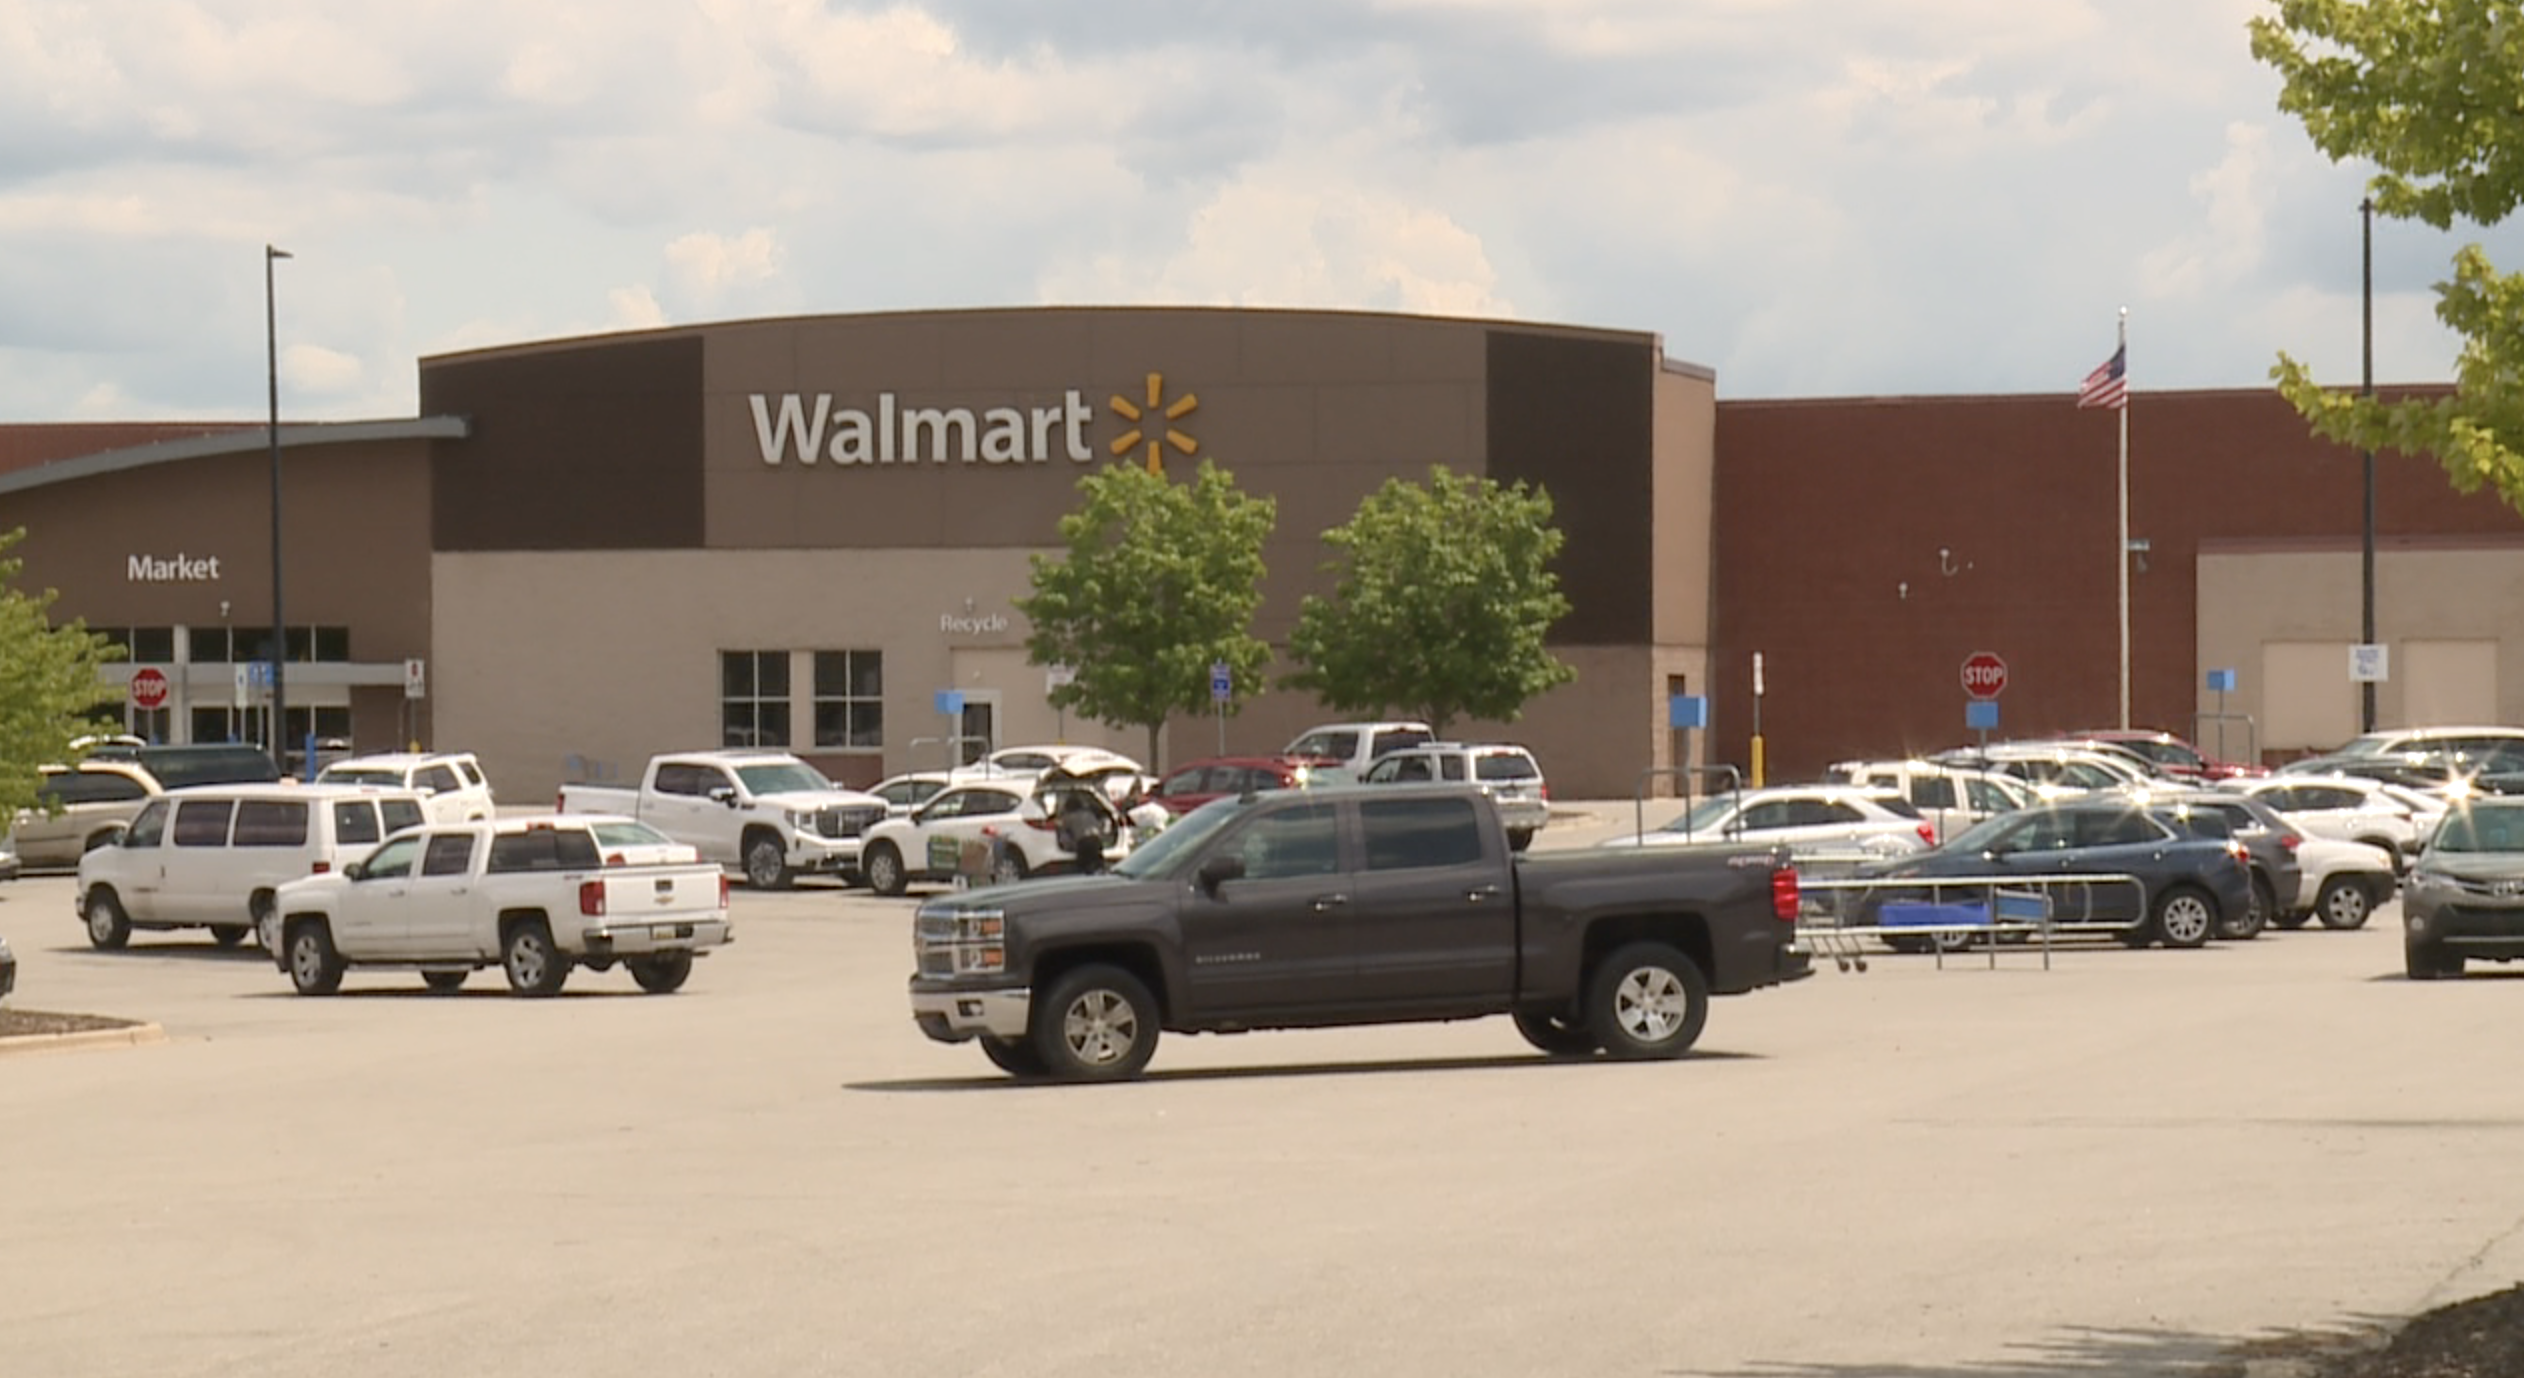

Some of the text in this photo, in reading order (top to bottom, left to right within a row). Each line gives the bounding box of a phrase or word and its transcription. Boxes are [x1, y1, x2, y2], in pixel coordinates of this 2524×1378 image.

[749, 390, 1093, 464] Walmart
[128, 552, 219, 581] Market
[940, 613, 1008, 635] Recycle
[1965, 666, 2003, 685] STOP
[133, 678, 167, 698] STOP
